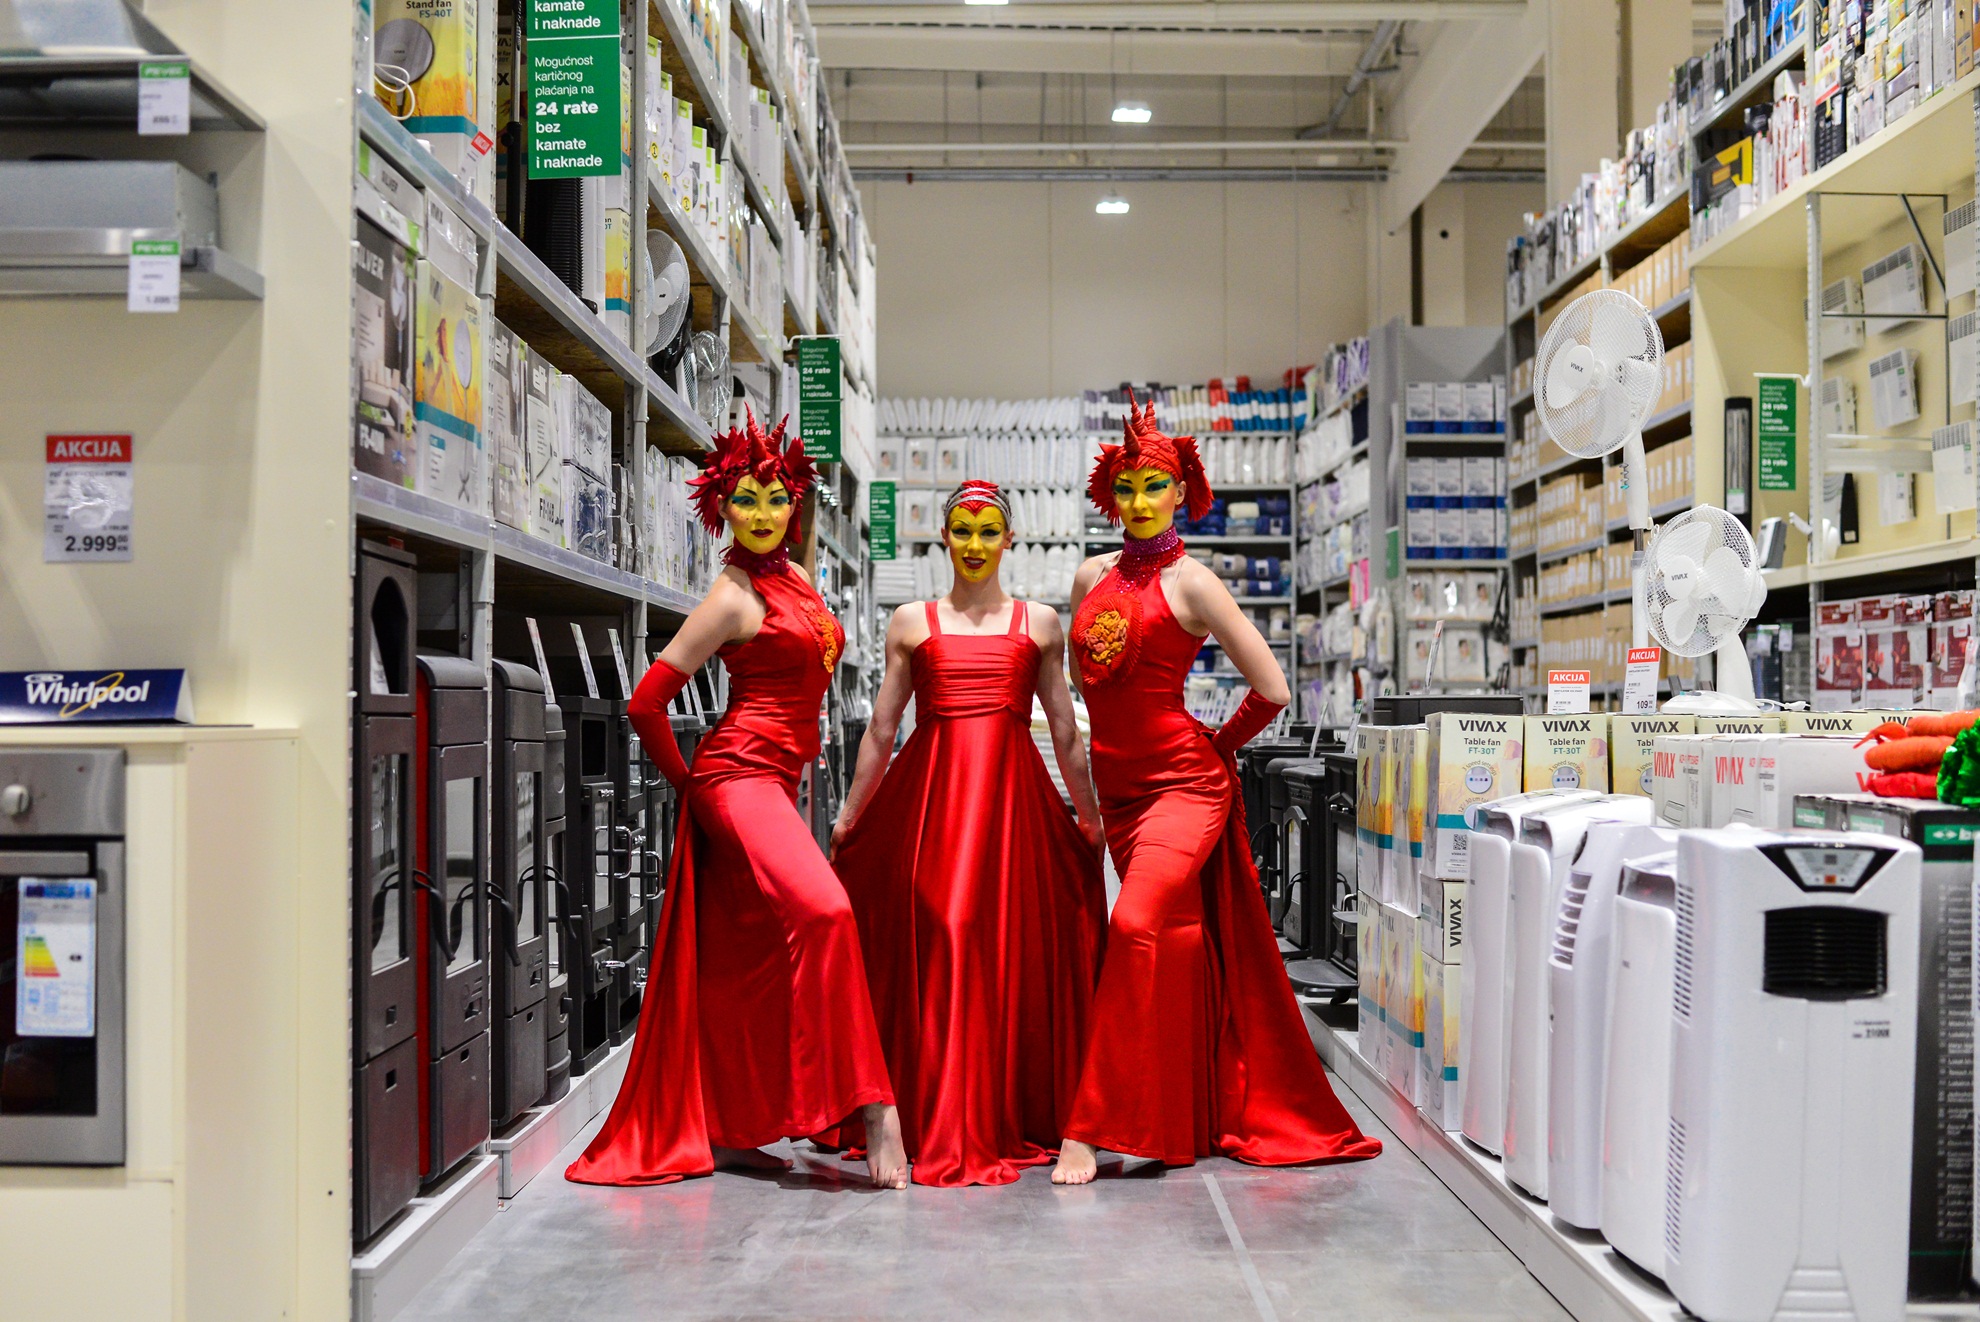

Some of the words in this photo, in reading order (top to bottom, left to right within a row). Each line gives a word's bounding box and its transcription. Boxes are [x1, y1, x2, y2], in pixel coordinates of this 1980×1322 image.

[534, 0, 585, 12] kamate
[419, 9, 452, 18] FS-40T
[534, 18, 539, 30] i
[542, 15, 602, 30] naknade
[534, 55, 594, 69] Mogućnost
[534, 70, 584, 82] kartičnog
[535, 84, 579, 98] plaćanja
[581, 85, 594, 94] na
[536, 102, 559, 116] 24
[563, 100, 599, 115] rate
[536, 121, 561, 134] bez
[536, 138, 587, 151] kamate
[536, 156, 540, 168] i
[544, 155, 603, 169] naknade
[815, 428, 832, 436] rate
[54, 440, 123, 458] AKCIJA
[65, 535, 117, 552] 2.999
[1630, 650, 1656, 660] AKCIJA
[1552, 673, 1585, 682] AKCIJA
[26, 680, 150, 709] Whirlpool
[1636, 700, 1649, 709] 109
[1458, 720, 1508, 733] VIVAX
[1542, 720, 1591, 733] VIVAX
[1630, 721, 1680, 734] VIVAX
[1716, 724, 1764, 734] VIVAX
[1805, 718, 1853, 731] VIVAX
[1464, 738, 1486, 746] Table
[1487, 738, 1501, 746] fan
[1548, 738, 1571, 746] Table
[1572, 738, 1586, 746] fan
[1468, 746, 1496, 755] FT-30T
[1553, 747, 1581, 755] FT-30T
[1466, 760, 1481, 769] speed
[1552, 760, 1567, 768] speed
[1654, 752, 1676, 778] VIVAX
[1450, 898, 1462, 948] VIVAX
